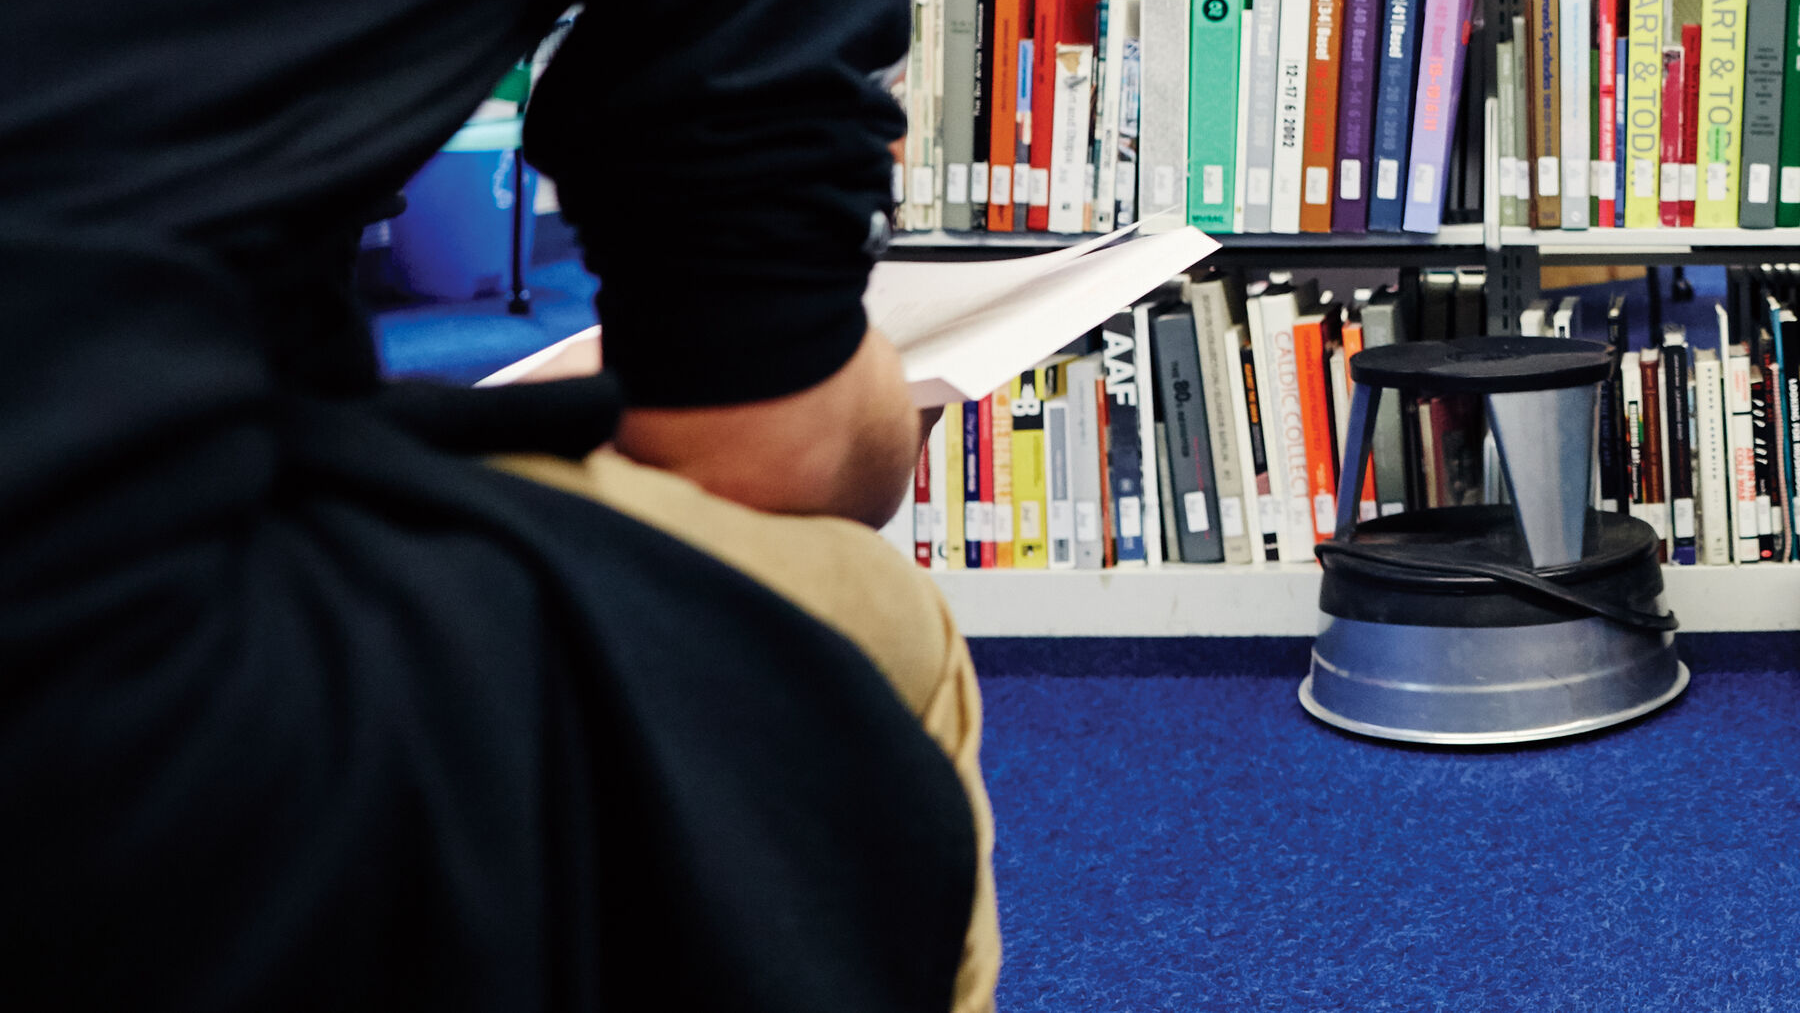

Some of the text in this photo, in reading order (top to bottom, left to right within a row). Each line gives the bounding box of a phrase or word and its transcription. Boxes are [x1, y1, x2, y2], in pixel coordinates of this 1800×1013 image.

[1208, 0, 1224, 17] 2
[1392, 4, 1406, 20] 41
[1315, 27, 1331, 61] Basel
[1352, 29, 1367, 62] Basel
[1389, 25, 1405, 58] Basel
[1431, 25, 1446, 57] Basel
[1540, 30, 1554, 91] Spectacles
[1632, 61, 1658, 83] &
[1709, 57, 1736, 80] &
[1283, 118, 1297, 148] 2002
[1631, 89, 1658, 193] TOD
[1102, 329, 1137, 407] AAF
[1170, 361, 1178, 379] THE
[1274, 331, 1309, 500] CALDIC COLLECT
[1788, 378, 1800, 422] LOOKING
[1752, 398, 1767, 465] POP ART
[1744, 447, 1755, 467] ART
[1735, 447, 1746, 501] COLD WAR
[1745, 470, 1756, 482] IN
